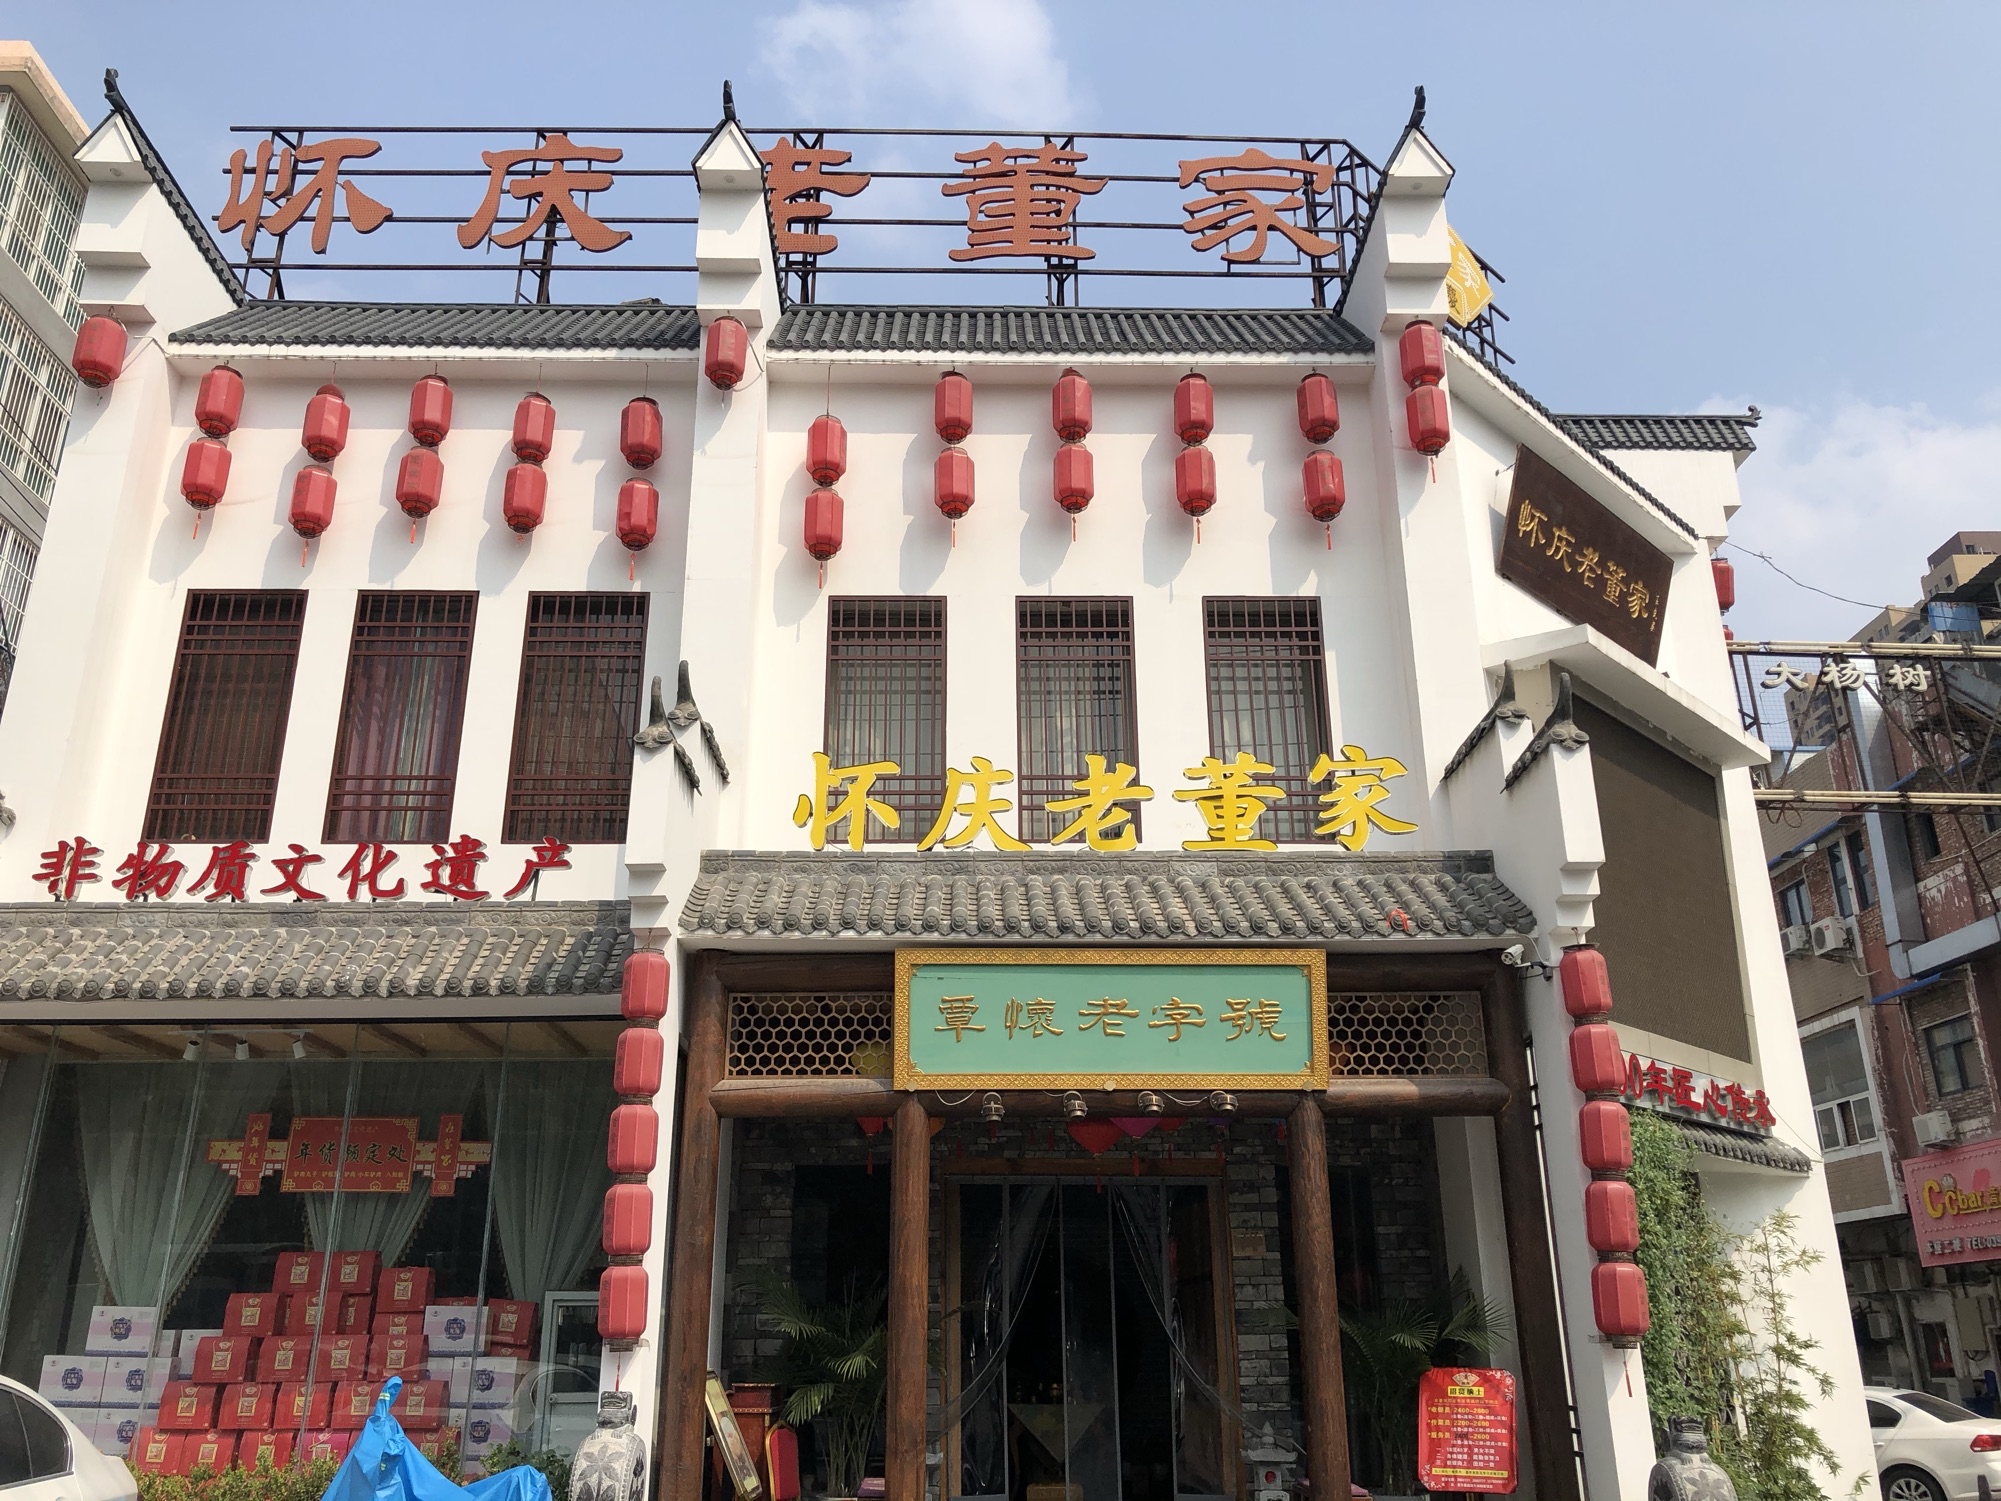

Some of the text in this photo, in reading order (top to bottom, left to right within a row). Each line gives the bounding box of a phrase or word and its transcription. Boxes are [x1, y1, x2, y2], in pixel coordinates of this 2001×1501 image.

[1518, 499, 1650, 619] 怀庆老董家
[1760, 660, 1932, 694] 大杨树
[793, 744, 1420, 853] 怀庆老董家
[32, 834, 574, 902] 非物质文化遗产
[1618, 1050, 1777, 1128] 0年匠心传承
